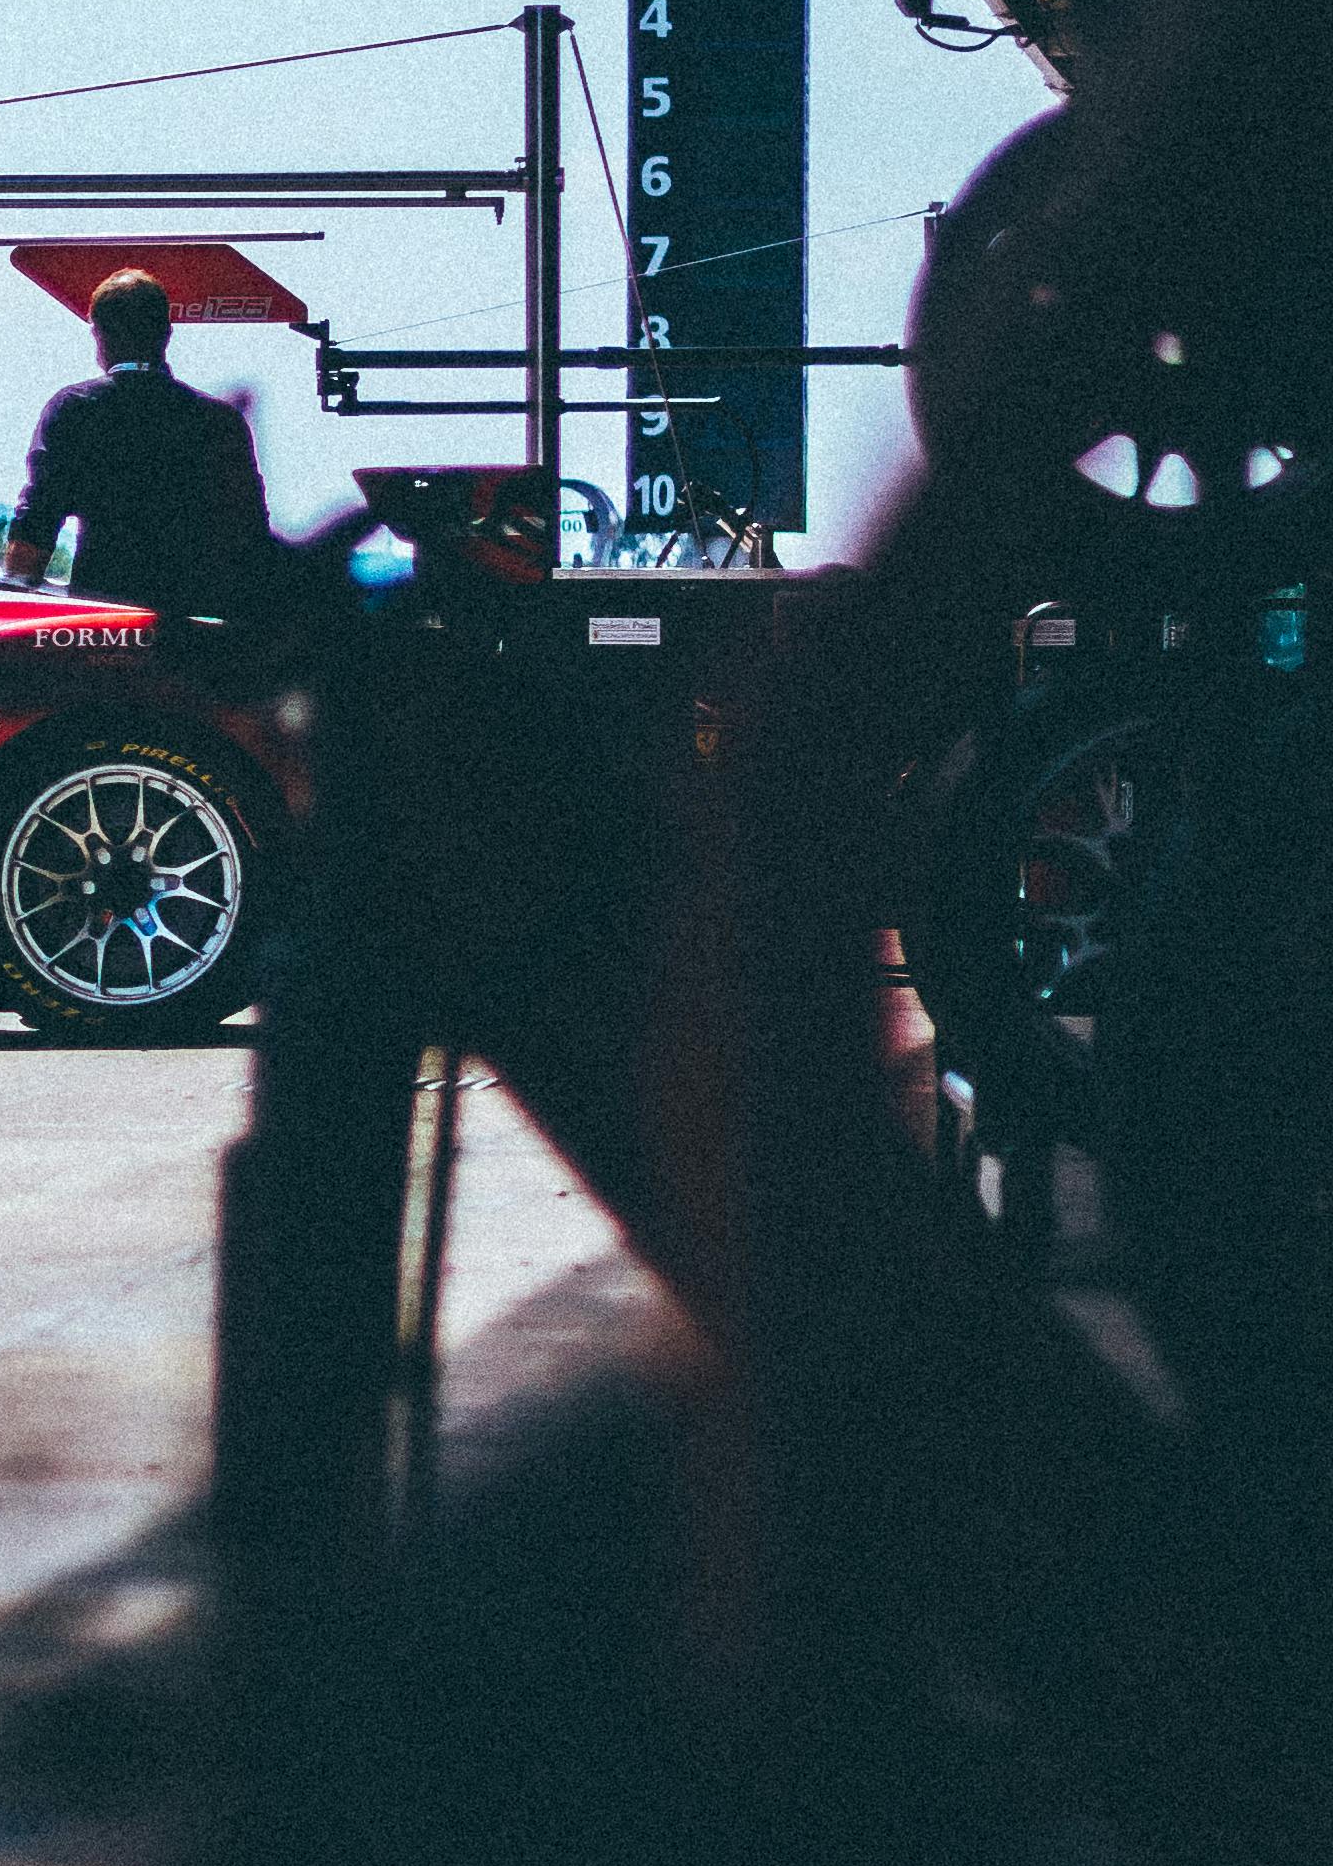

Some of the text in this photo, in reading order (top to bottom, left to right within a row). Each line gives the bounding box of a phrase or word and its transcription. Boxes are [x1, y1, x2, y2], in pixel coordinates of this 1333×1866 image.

[642, 77, 672, 118] 5
[641, 155, 673, 197] 6
[640, 235, 670, 277] 7
[639, 315, 671, 349] 8
[633, 473, 675, 516] 10
[33, 627, 155, 648] FORMU
